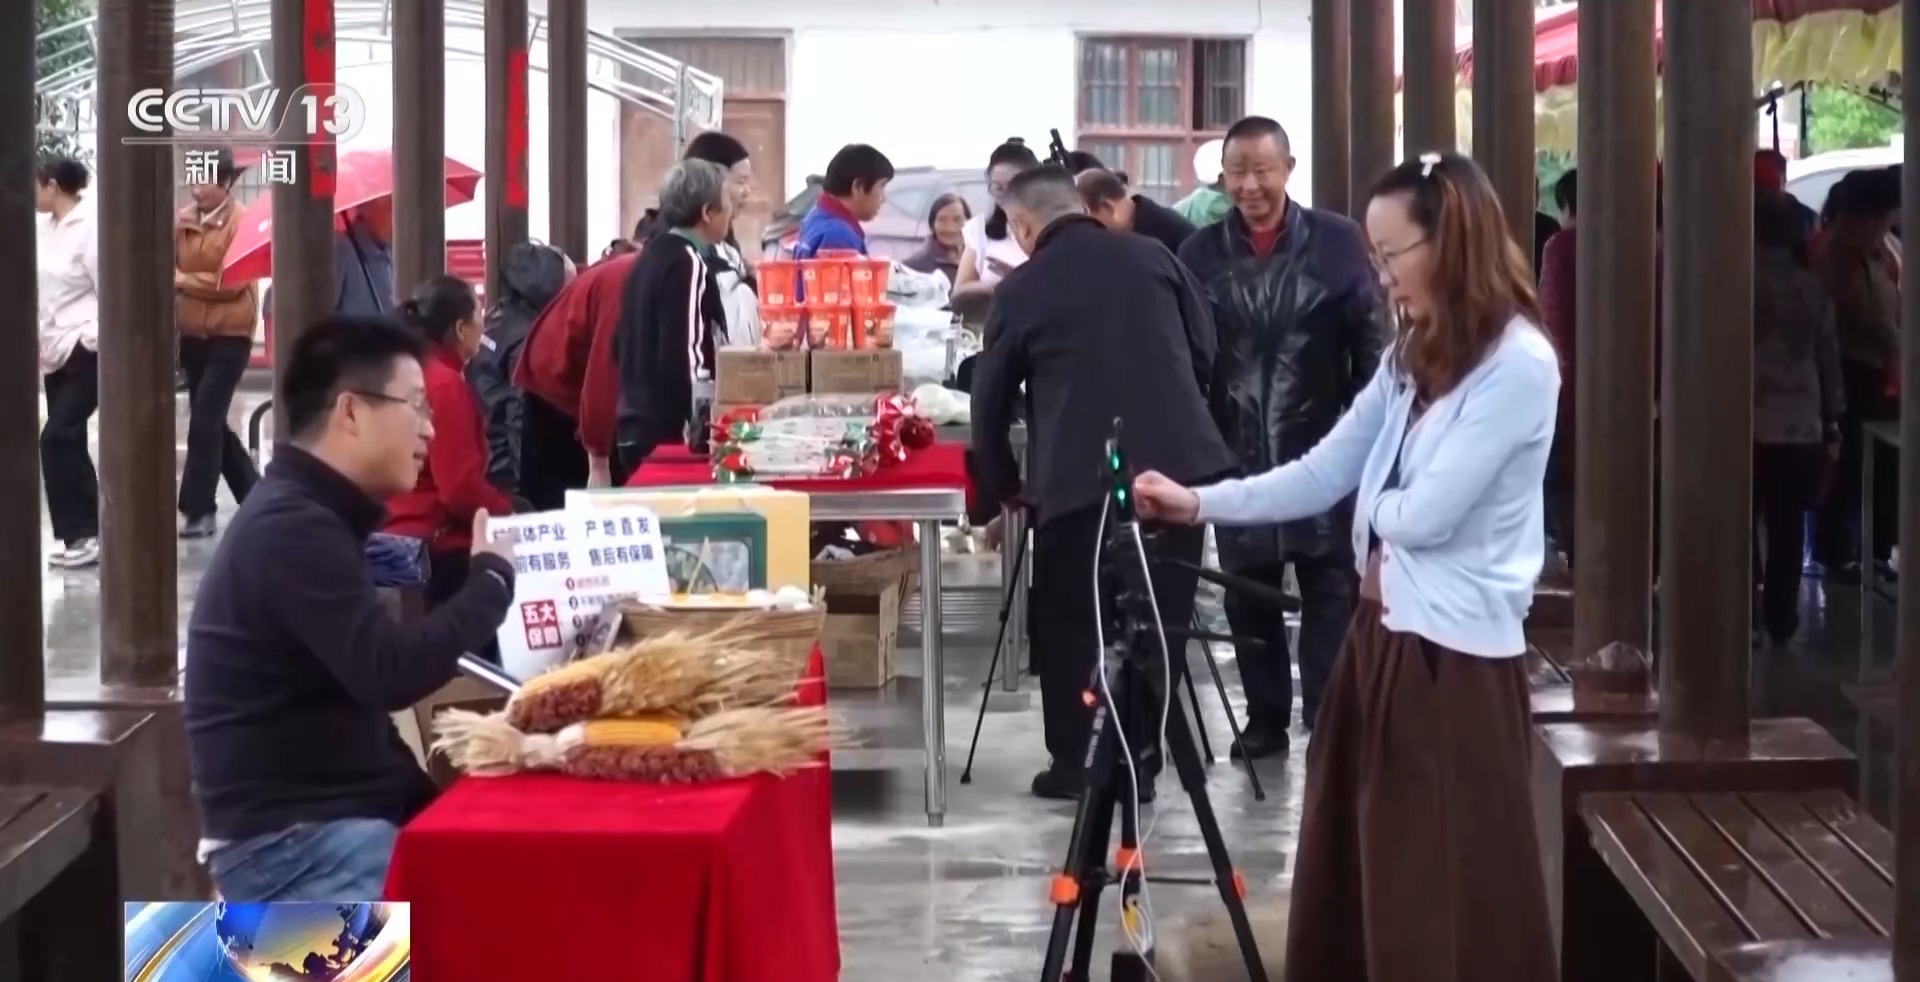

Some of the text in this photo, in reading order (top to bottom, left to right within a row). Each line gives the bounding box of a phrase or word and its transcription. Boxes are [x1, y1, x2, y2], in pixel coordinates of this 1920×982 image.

[493, 516, 650, 544] 体产业 产地直发
[589, 543, 654, 567] 售后有保障
[522, 602, 556, 625] 五大
